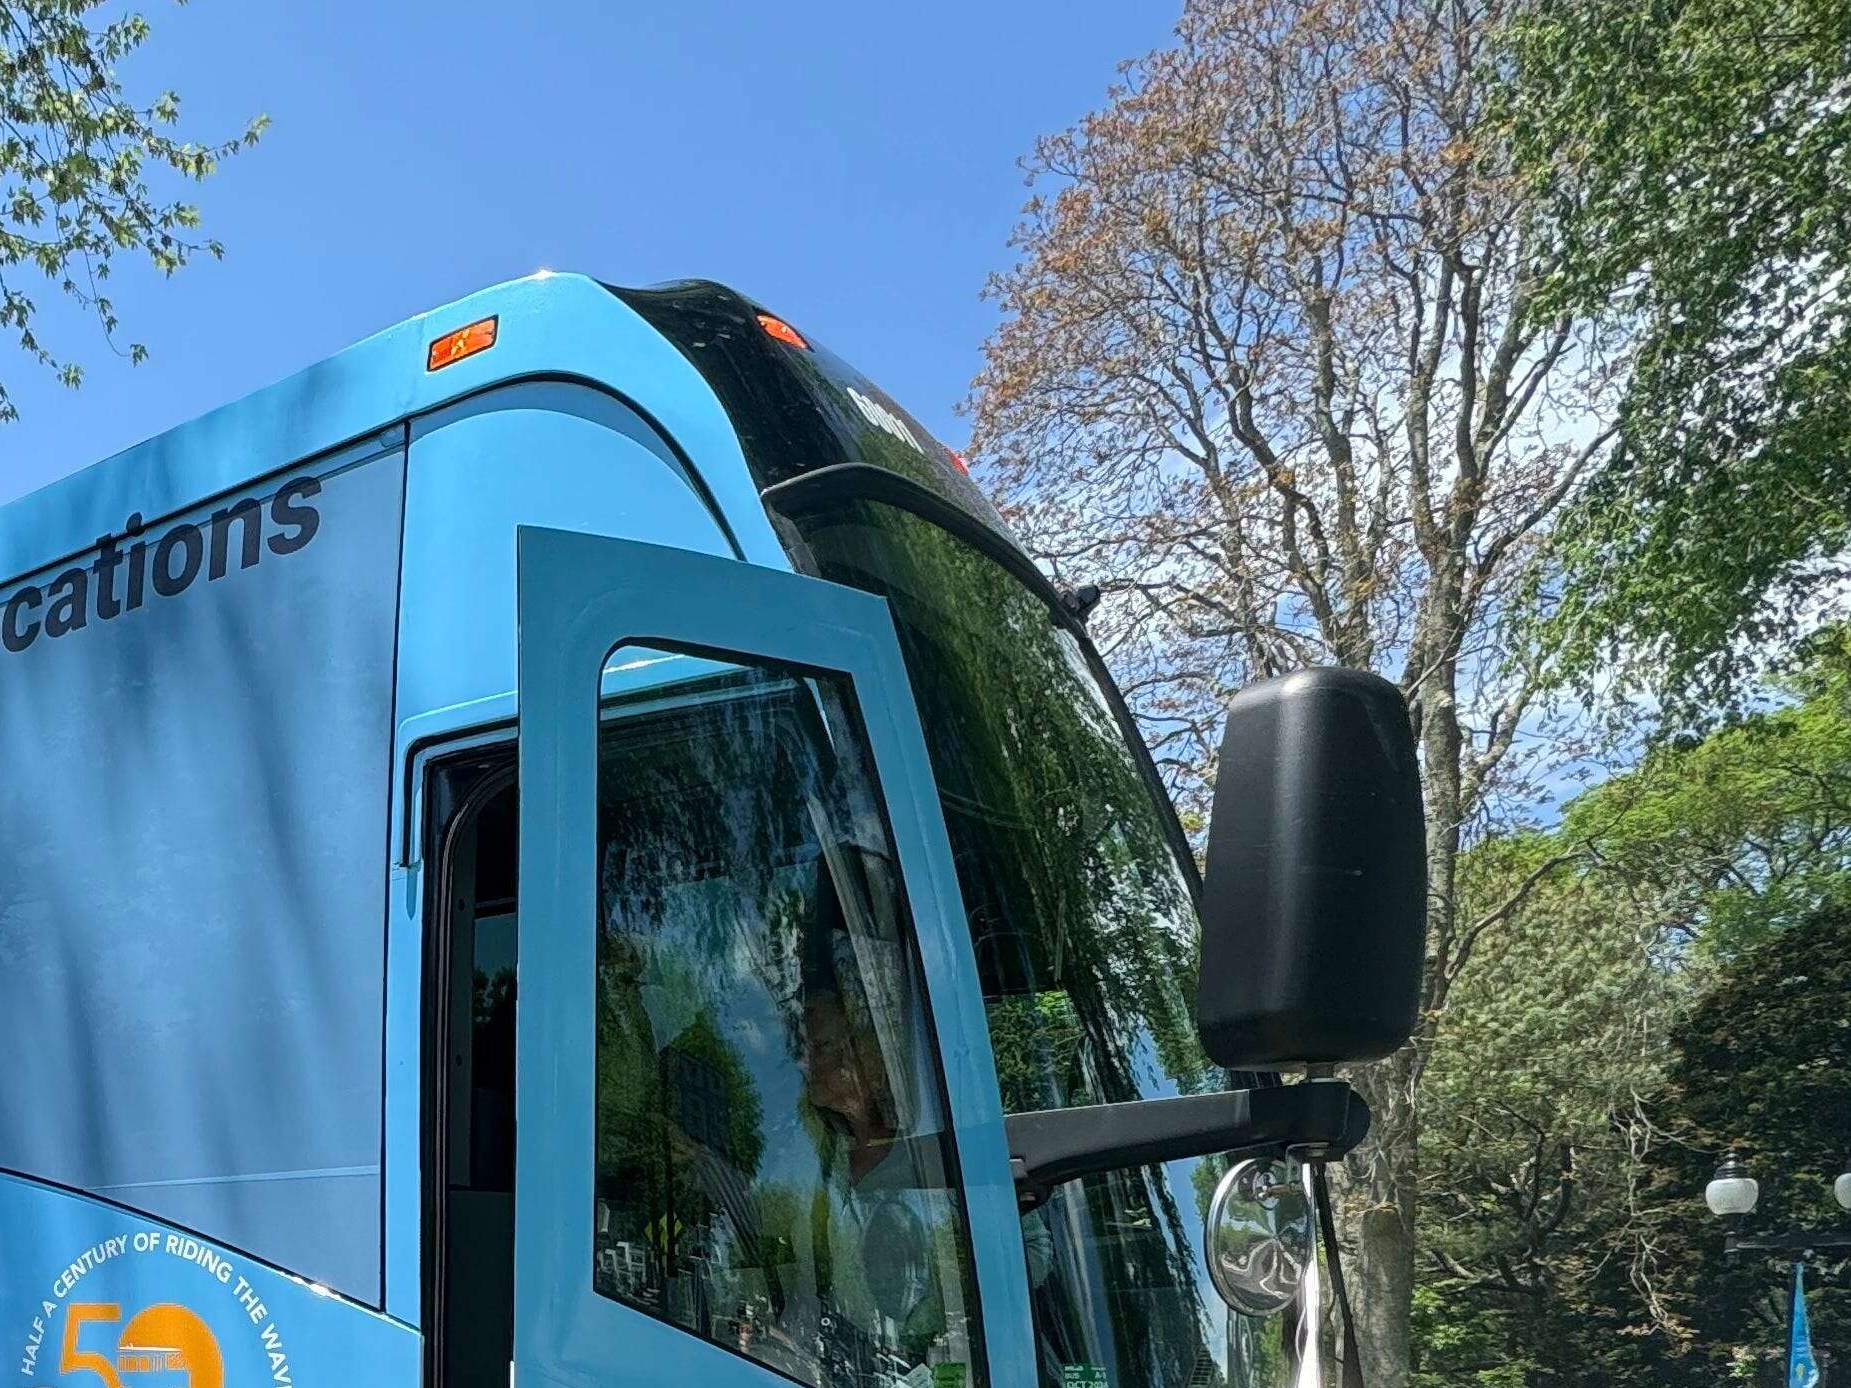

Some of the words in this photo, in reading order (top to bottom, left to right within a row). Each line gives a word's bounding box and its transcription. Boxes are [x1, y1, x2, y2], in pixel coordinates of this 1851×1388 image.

[21, 1316, 45, 1376] HALF
[41, 1299, 58, 1318] A
[53, 1234, 128, 1298] CENTURY
[133, 1232, 161, 1251] OF
[165, 1234, 234, 1284] RIDING
[231, 1275, 268, 1324] THE
